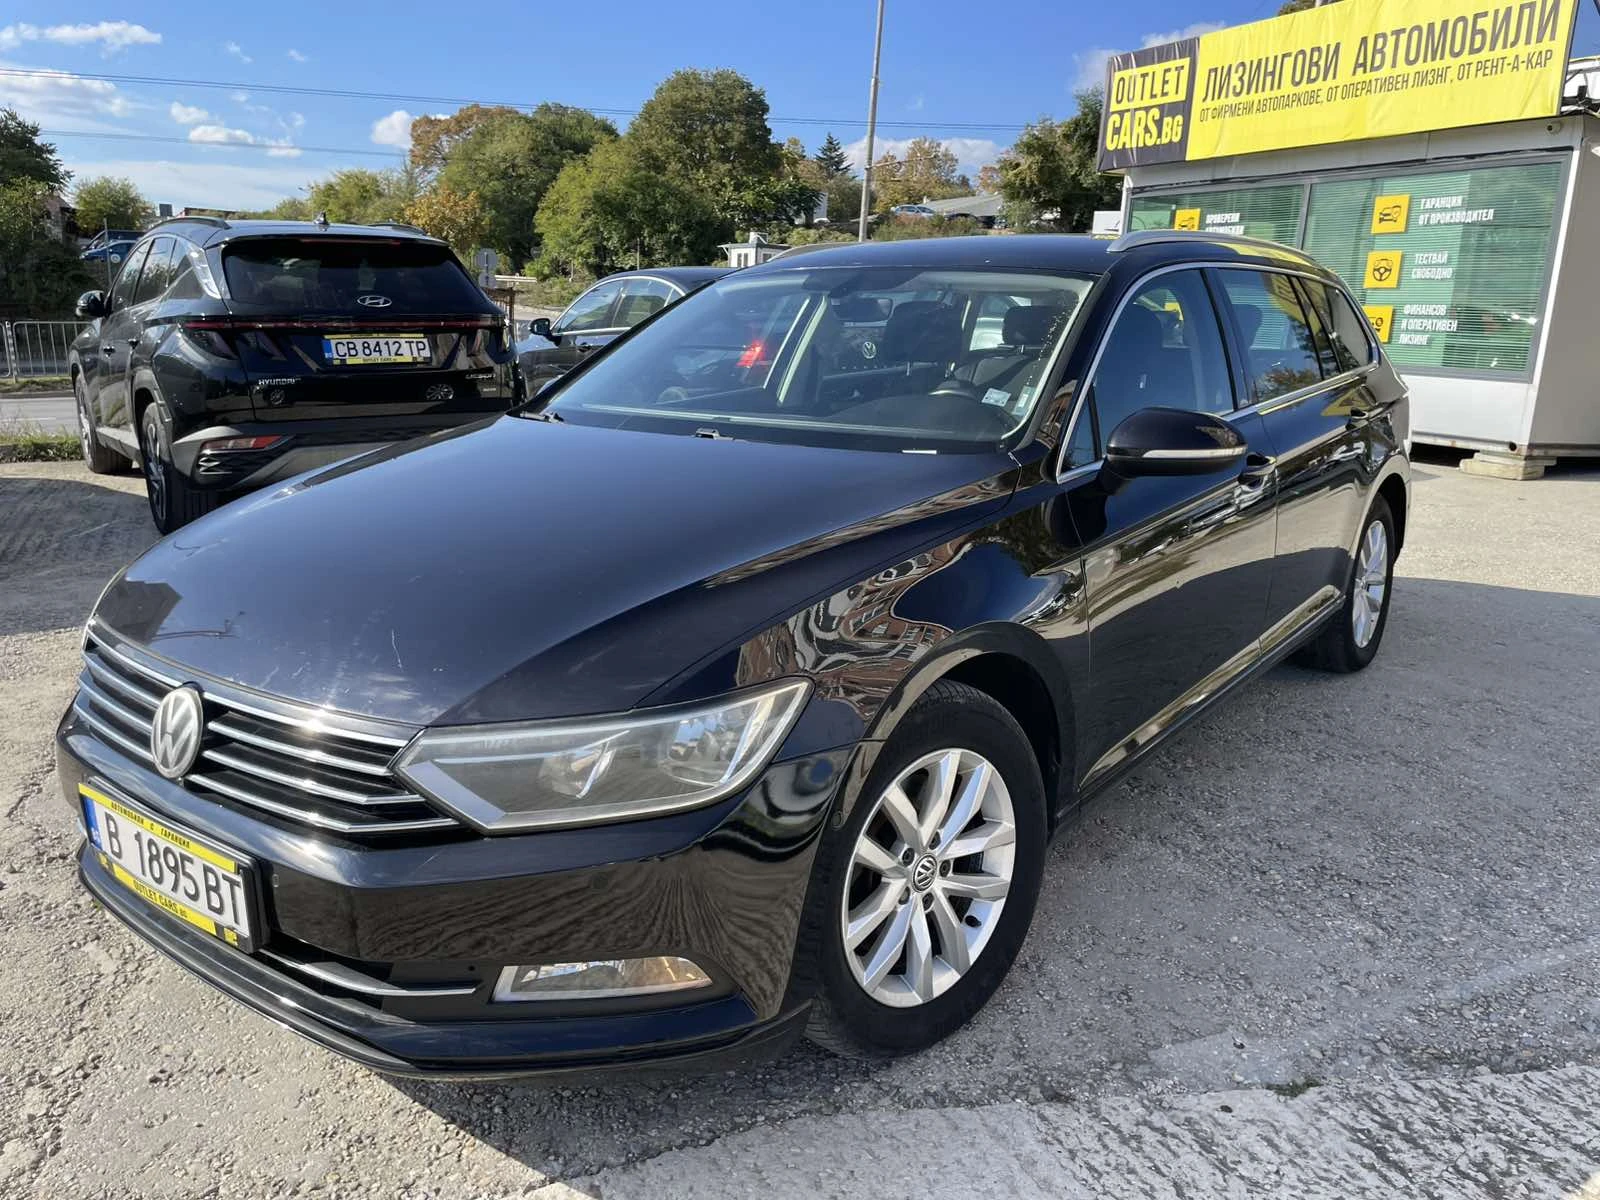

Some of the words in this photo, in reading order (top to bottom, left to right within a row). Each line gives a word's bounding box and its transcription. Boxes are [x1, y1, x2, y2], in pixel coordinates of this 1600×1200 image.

[1202, 41, 1341, 103] ЛИЗИНГОВИ
[1351, 0, 1561, 76] АВТОМОБИЛИ
[1115, 65, 1185, 104] OUTLET
[1199, 107, 1212, 122] ОТ
[1211, 100, 1257, 120] ФИРМЕНИ
[1256, 88, 1324, 112] АВТОПАРКОВЕ,
[1326, 85, 1340, 103] ОТ
[1340, 73, 1409, 101] ОПЕРАТИВЕН
[1456, 60, 1473, 81] ОТ
[1474, 49, 1553, 79] РЕНТ-А-КАР
[1105, 107, 1184, 151] CARS.BG
[1420, 195, 1464, 210] ГАРАНЦИЯ
[1418, 213, 1430, 226] ОТ
[1430, 208, 1495, 224] ПРОИЗВОДИТЕЛ
[1414, 249, 1449, 265] ТЕСТВАЙ
[1411, 267, 1454, 281] СВОБОДНО
[1403, 303, 1447, 316] ФИНАНСОВ
[1400, 320, 1407, 332] И
[1407, 319, 1459, 332] ОПЕРАТИВЕН
[1398, 333, 1431, 346] ЛИЗИНГ
[361, 340, 404, 357] 8412
[258, 377, 296, 385] HYUNDAI
[104, 811, 123, 860] B
[134, 830, 200, 902] 1895
[202, 862, 242, 926] BT
